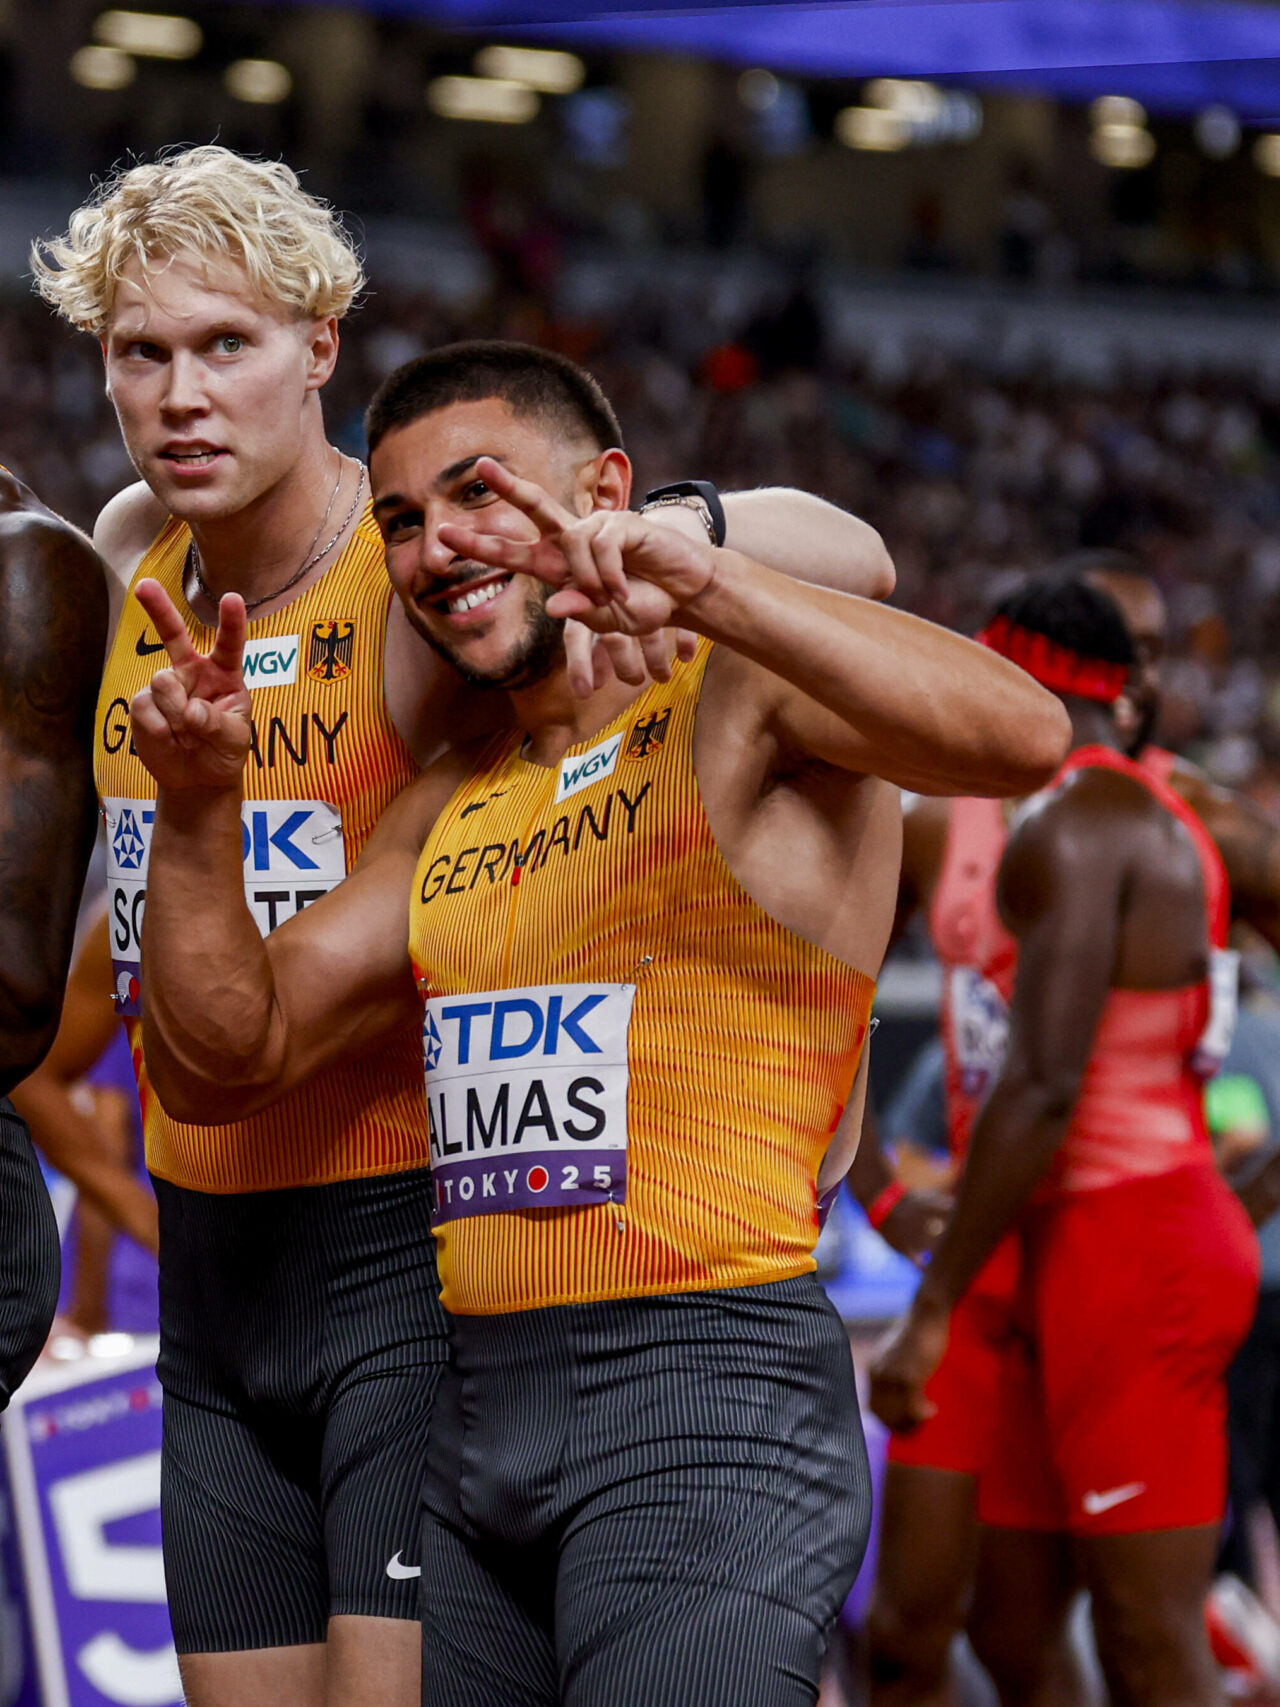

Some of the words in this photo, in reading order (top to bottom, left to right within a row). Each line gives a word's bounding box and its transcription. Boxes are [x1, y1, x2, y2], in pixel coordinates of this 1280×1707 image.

[562, 743, 620, 790] WGV
[421, 781, 652, 904] GERMANY
[441, 994, 609, 1065] TDK
[560, 1165, 613, 1191] 25
